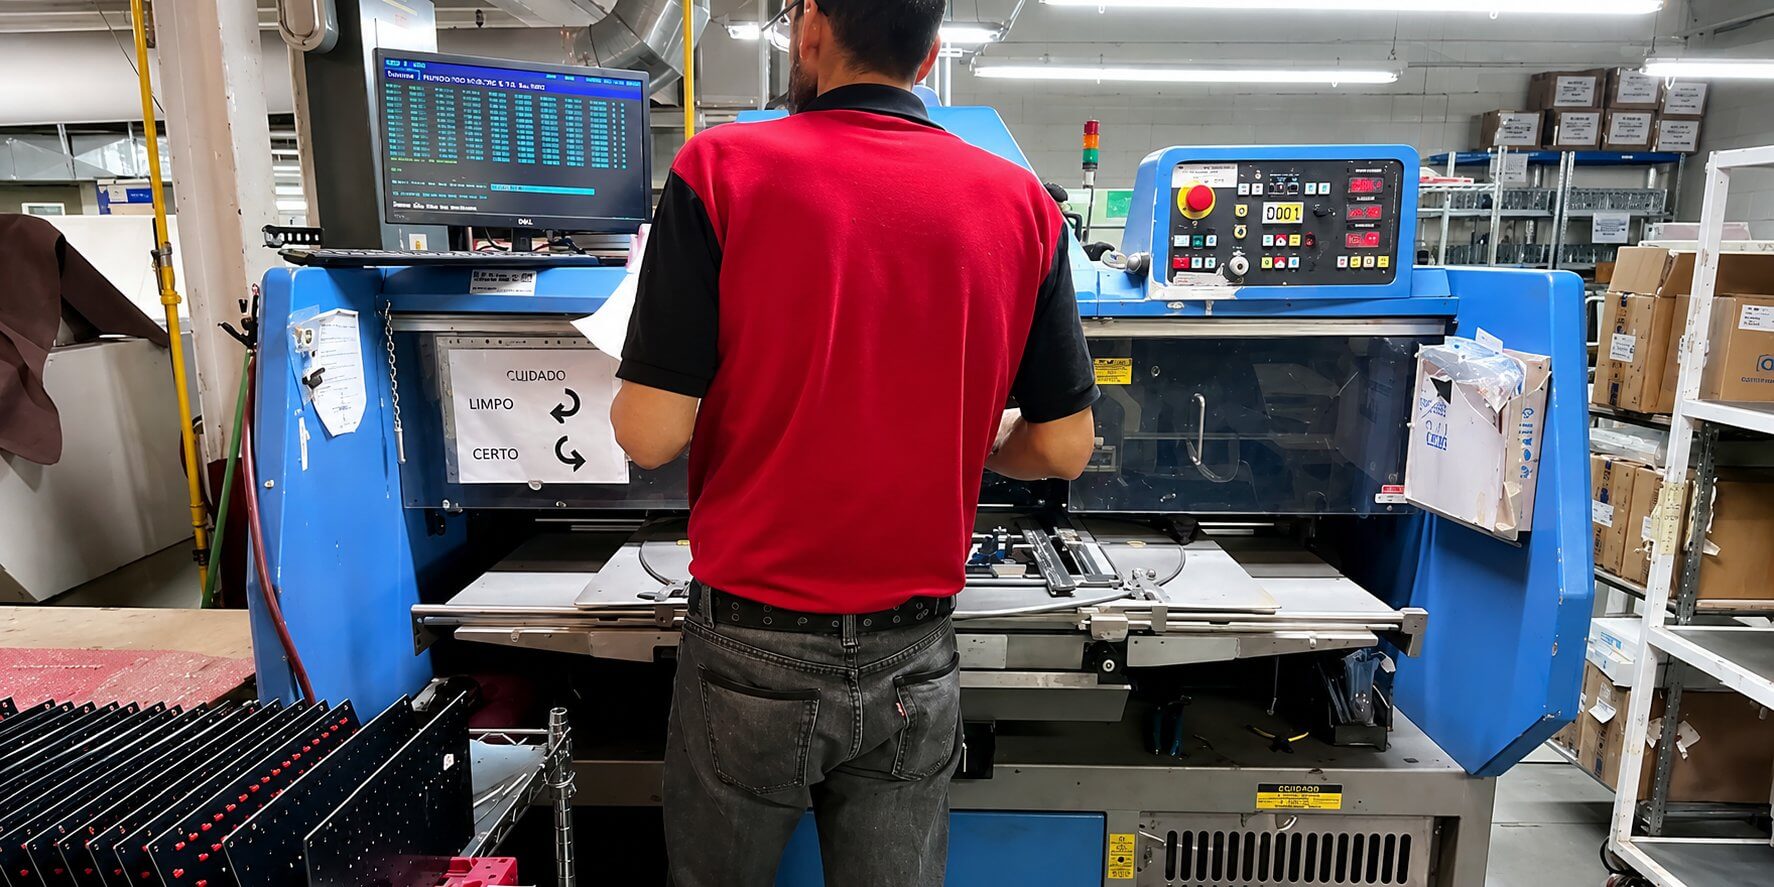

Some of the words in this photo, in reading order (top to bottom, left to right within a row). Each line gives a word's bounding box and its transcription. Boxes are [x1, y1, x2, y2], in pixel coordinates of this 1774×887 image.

[506, 370, 566, 382] CUIDADO
[469, 398, 514, 410] LIMPO
[473, 448, 519, 460] CERTO
